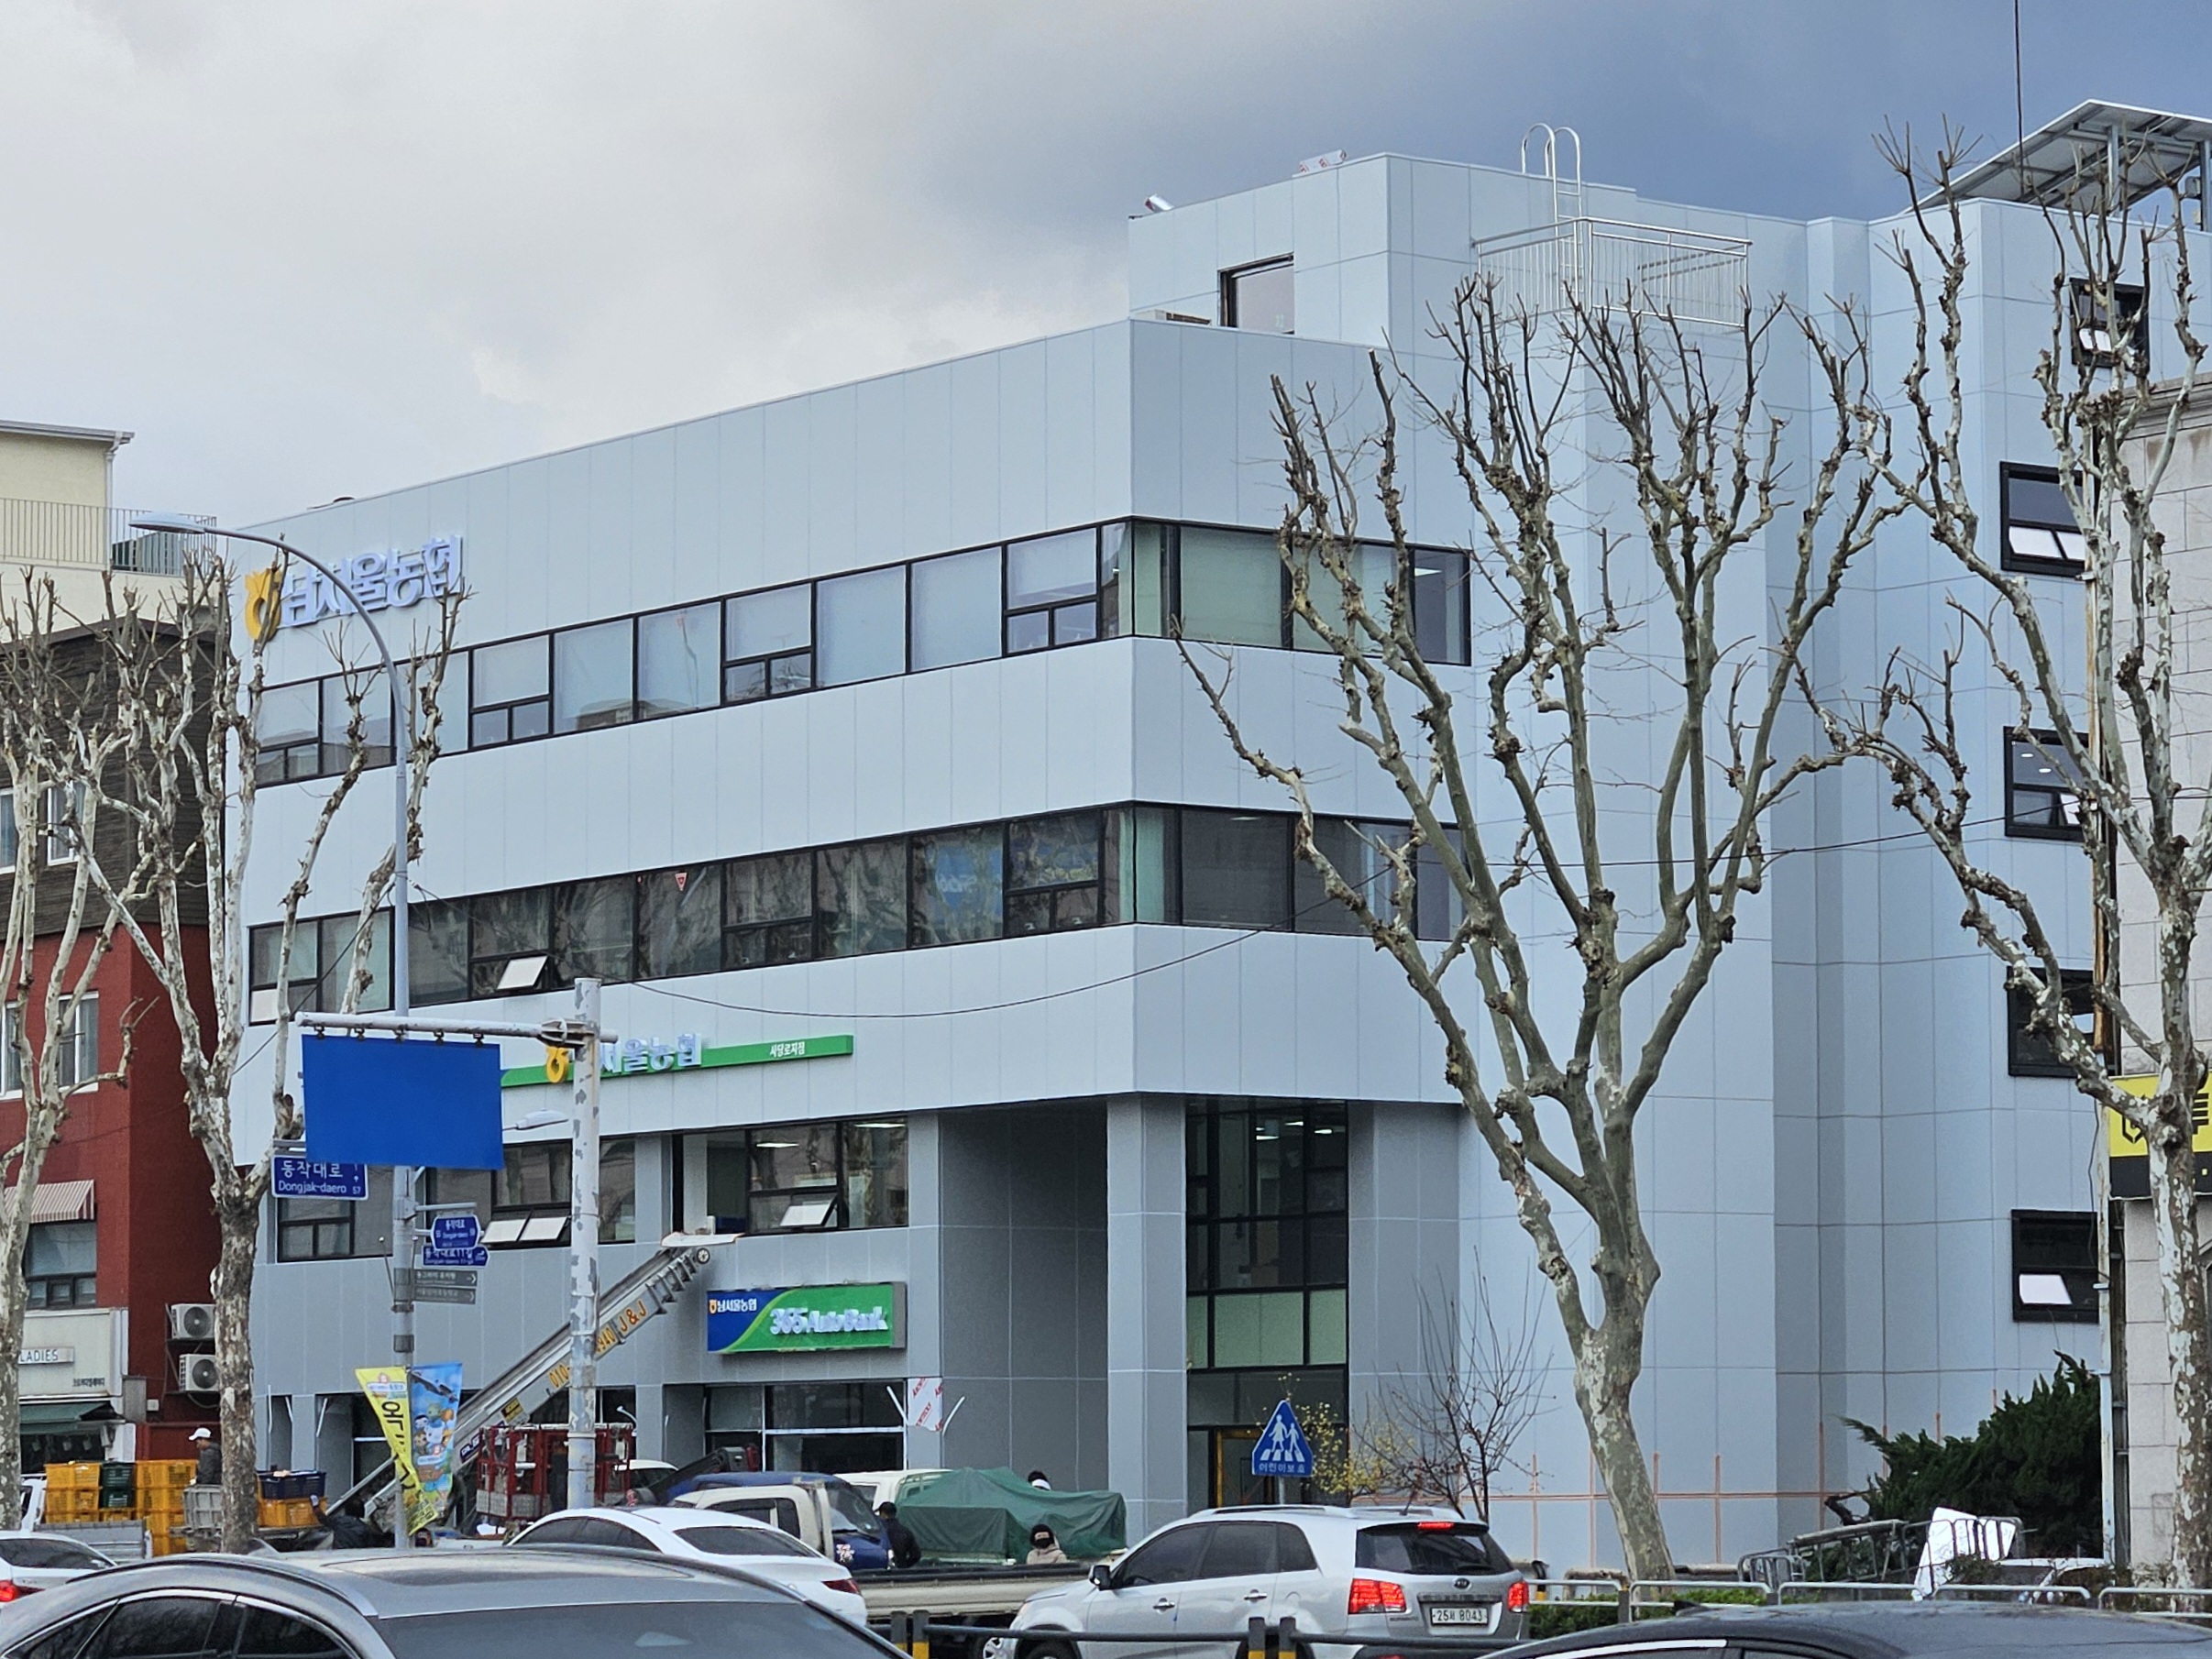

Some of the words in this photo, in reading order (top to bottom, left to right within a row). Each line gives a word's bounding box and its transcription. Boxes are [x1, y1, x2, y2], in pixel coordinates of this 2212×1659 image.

[281, 533, 463, 629] 남서울농협
[570, 1032, 704, 1075] 서울농협
[769, 1041, 806, 1058] 사당로지점
[281, 1160, 343, 1180] 동작대로
[279, 1180, 347, 1194] Dongjak-daero
[717, 1298, 757, 1313] 남서울농협
[769, 1307, 808, 1335] 365
[20, 1349, 59, 1363] LADIES
[1259, 1462, 1305, 1474] 어린이보호
